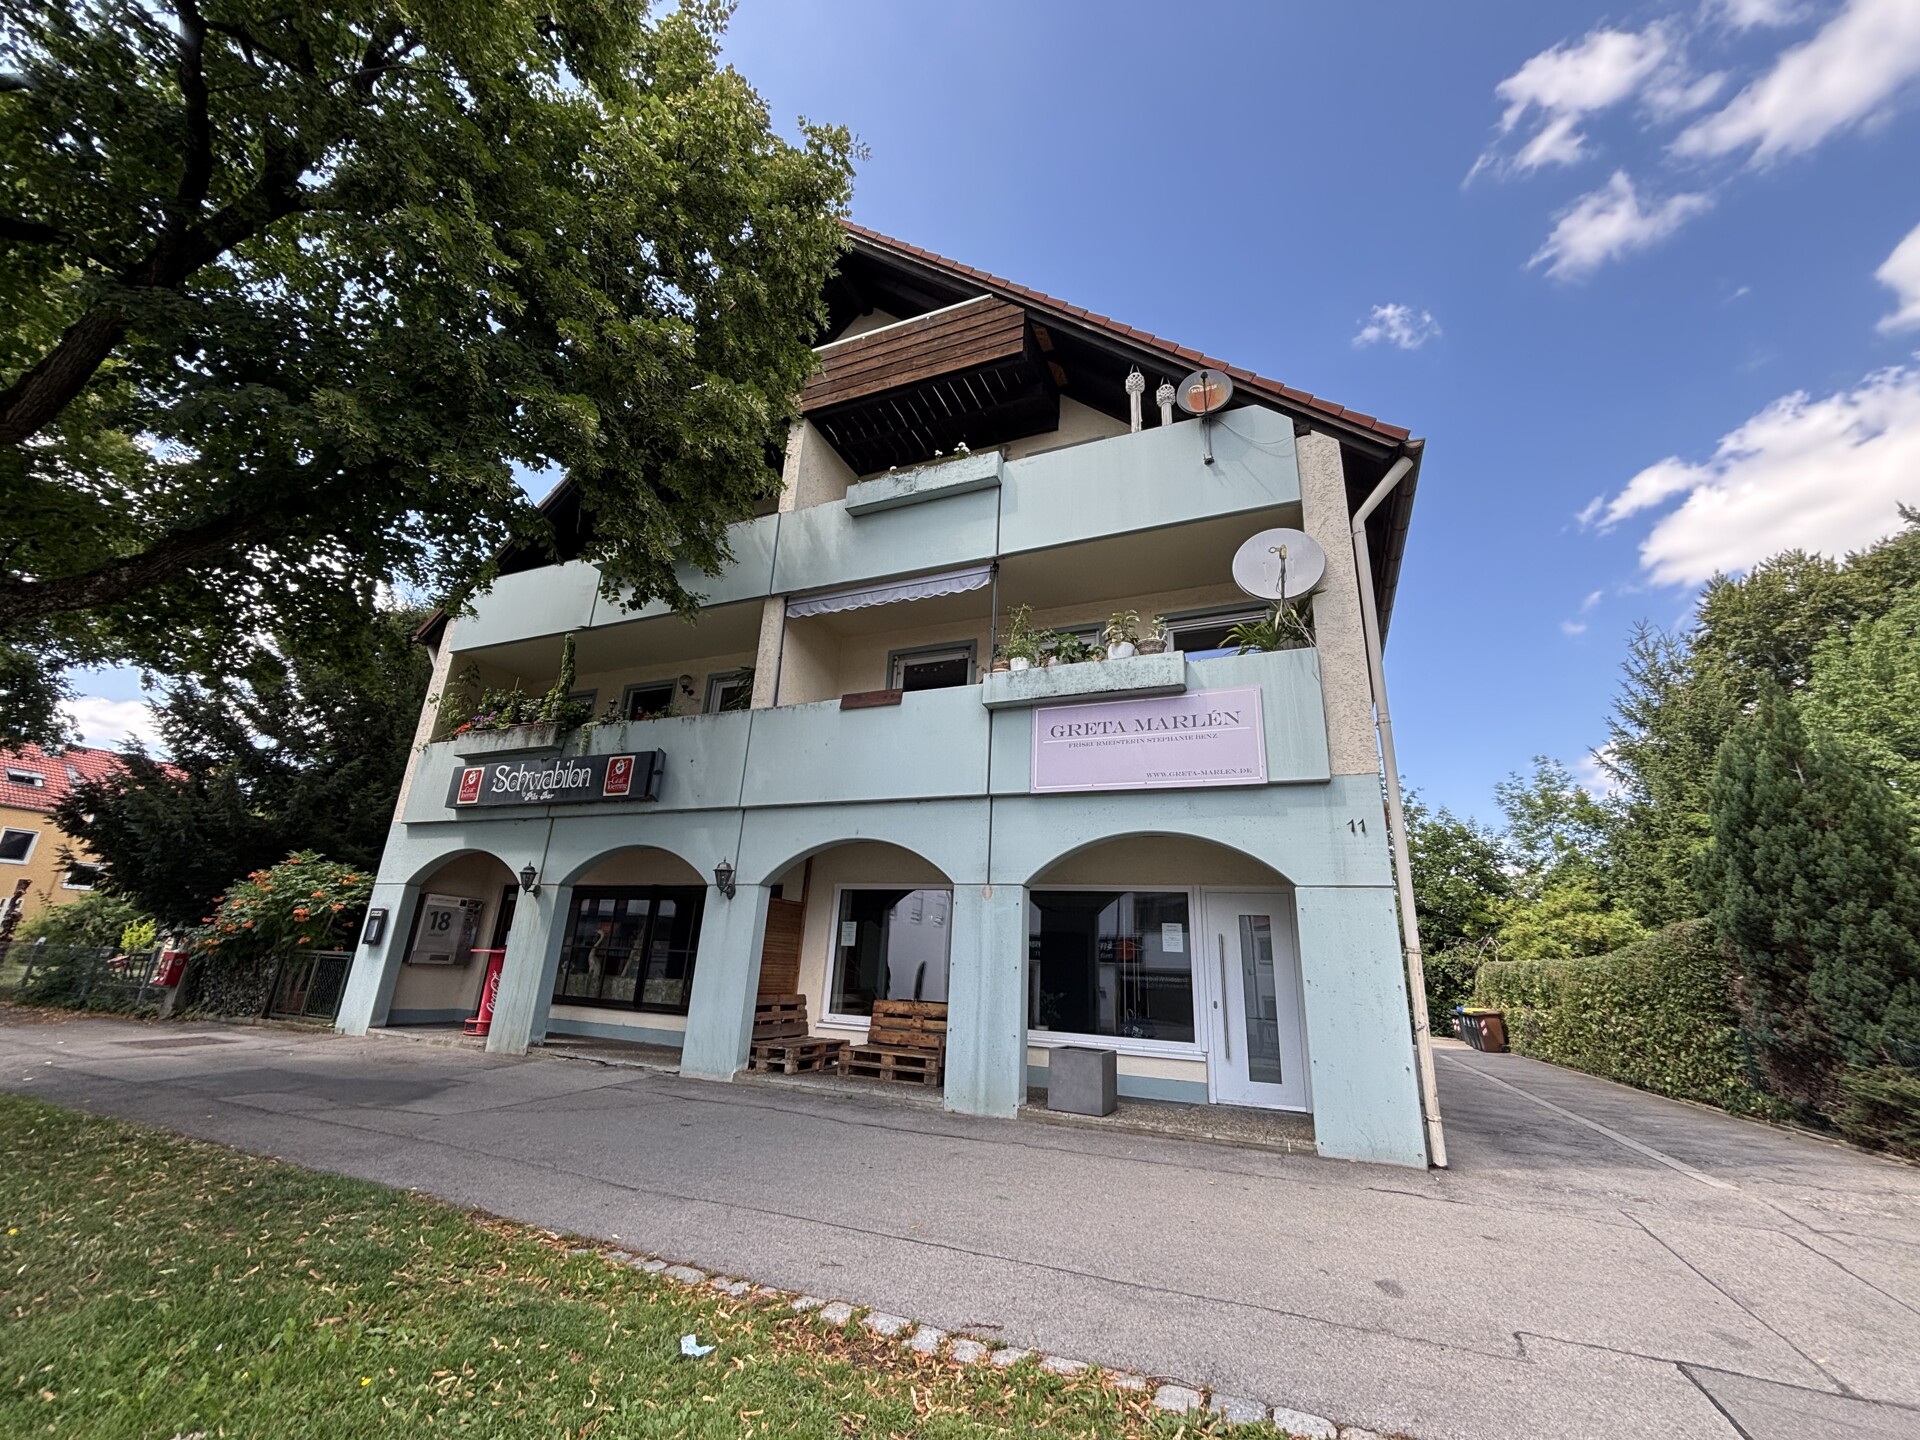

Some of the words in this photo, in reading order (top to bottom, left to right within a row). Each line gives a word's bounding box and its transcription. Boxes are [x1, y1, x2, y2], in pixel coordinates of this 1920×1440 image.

[1050, 720, 1127, 738] GRETA
[1134, 709, 1241, 731] MARLÉN
[1146, 734, 1195, 744] STEPHANIE
[491, 760, 592, 797] Schwabilon
[1346, 818, 1366, 833] 11
[430, 911, 451, 931] 18
